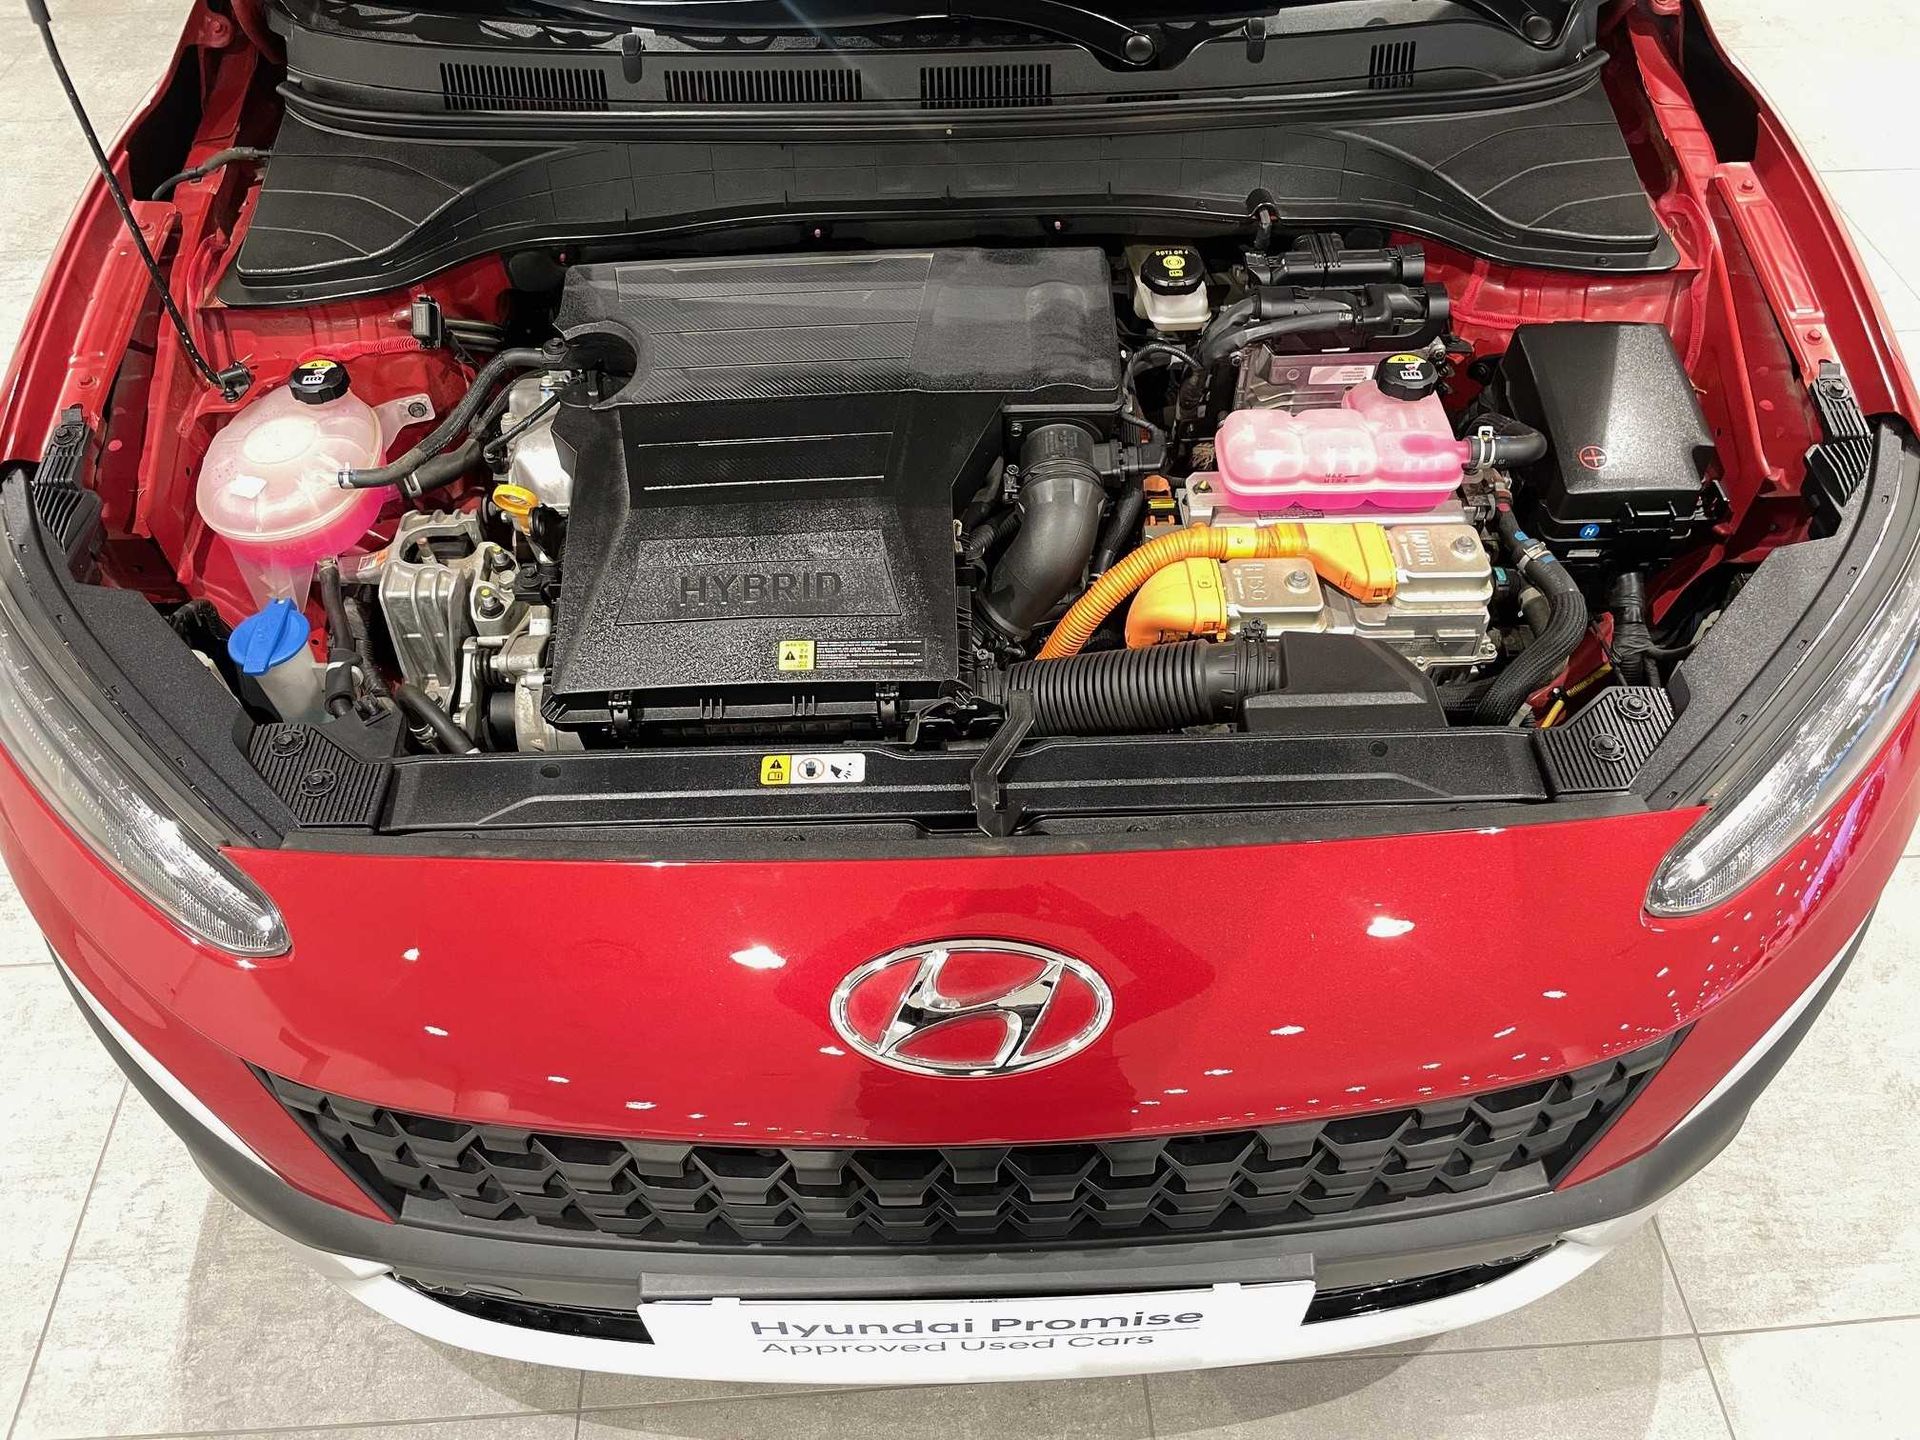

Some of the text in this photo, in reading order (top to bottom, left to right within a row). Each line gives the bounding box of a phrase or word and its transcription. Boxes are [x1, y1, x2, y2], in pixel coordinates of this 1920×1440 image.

[680, 572, 843, 604] HYBRID
[750, 1311, 1204, 1338] Hyundai Promise
[762, 1335, 1155, 1356] Approved Used Cars
